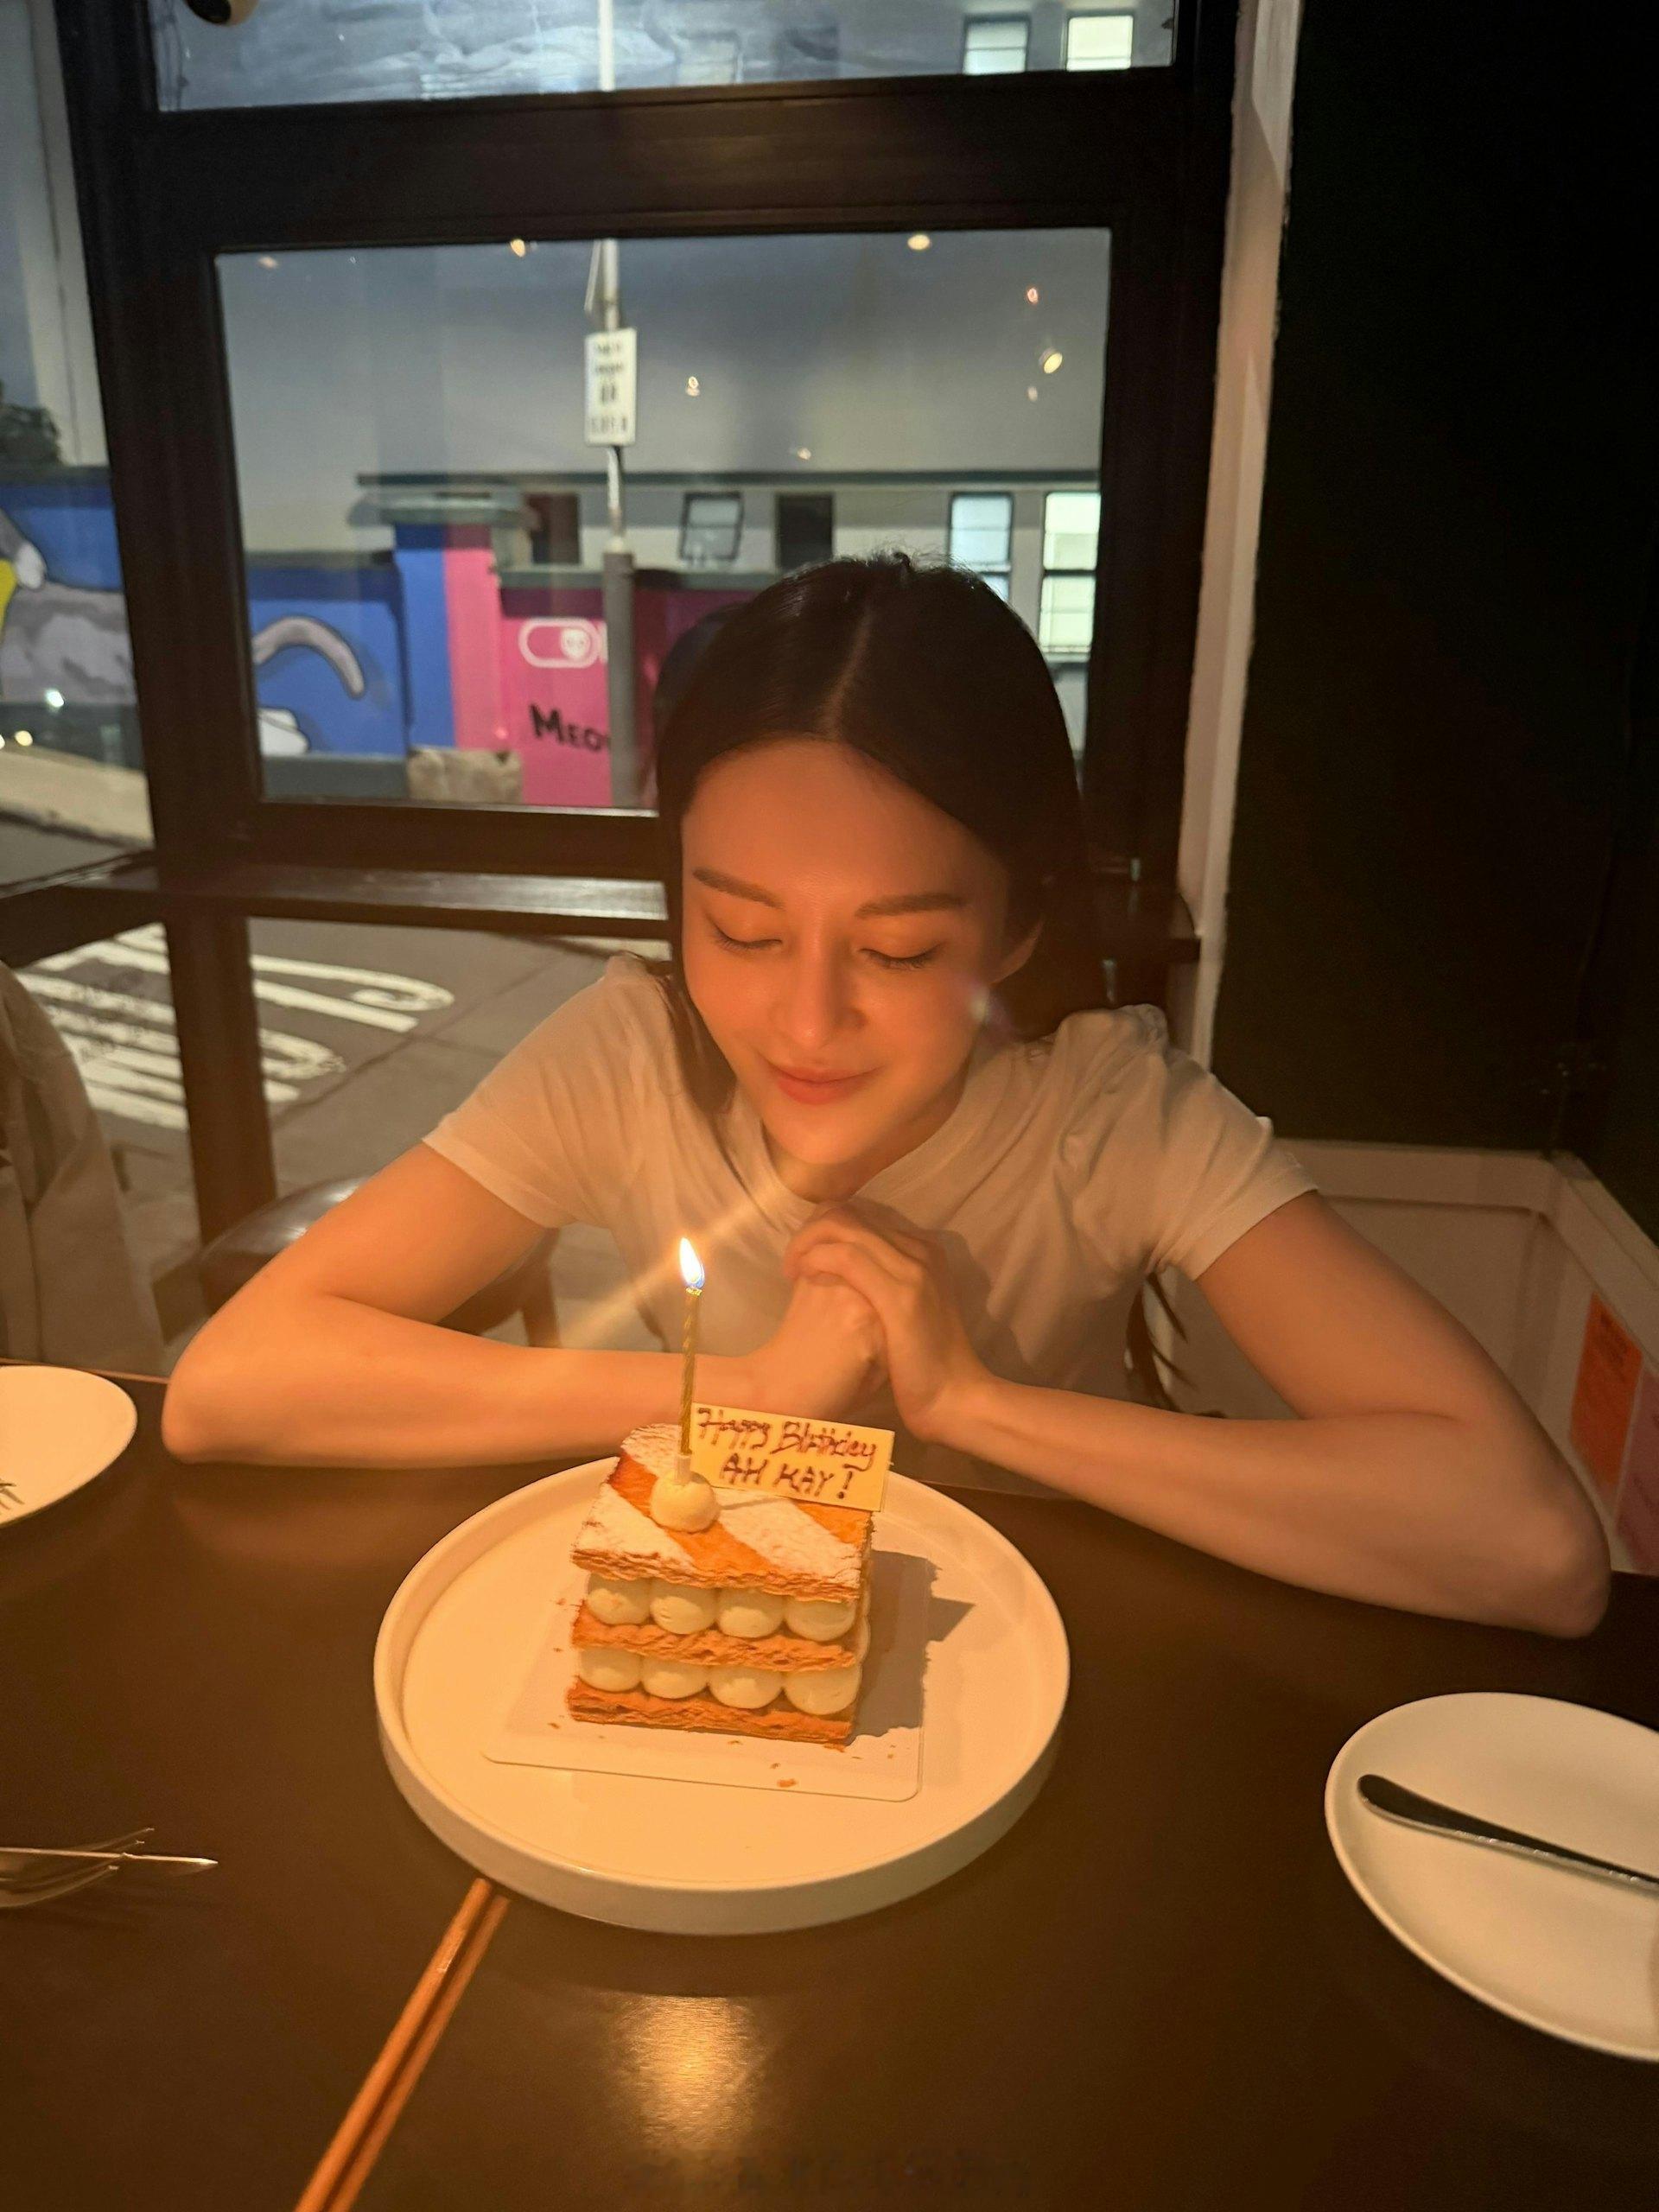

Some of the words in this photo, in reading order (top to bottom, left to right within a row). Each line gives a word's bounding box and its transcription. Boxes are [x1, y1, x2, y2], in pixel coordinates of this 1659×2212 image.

[529, 703, 610, 753] MEO
[698, 1408, 772, 1450] Happy
[720, 1452, 768, 1484] AH
